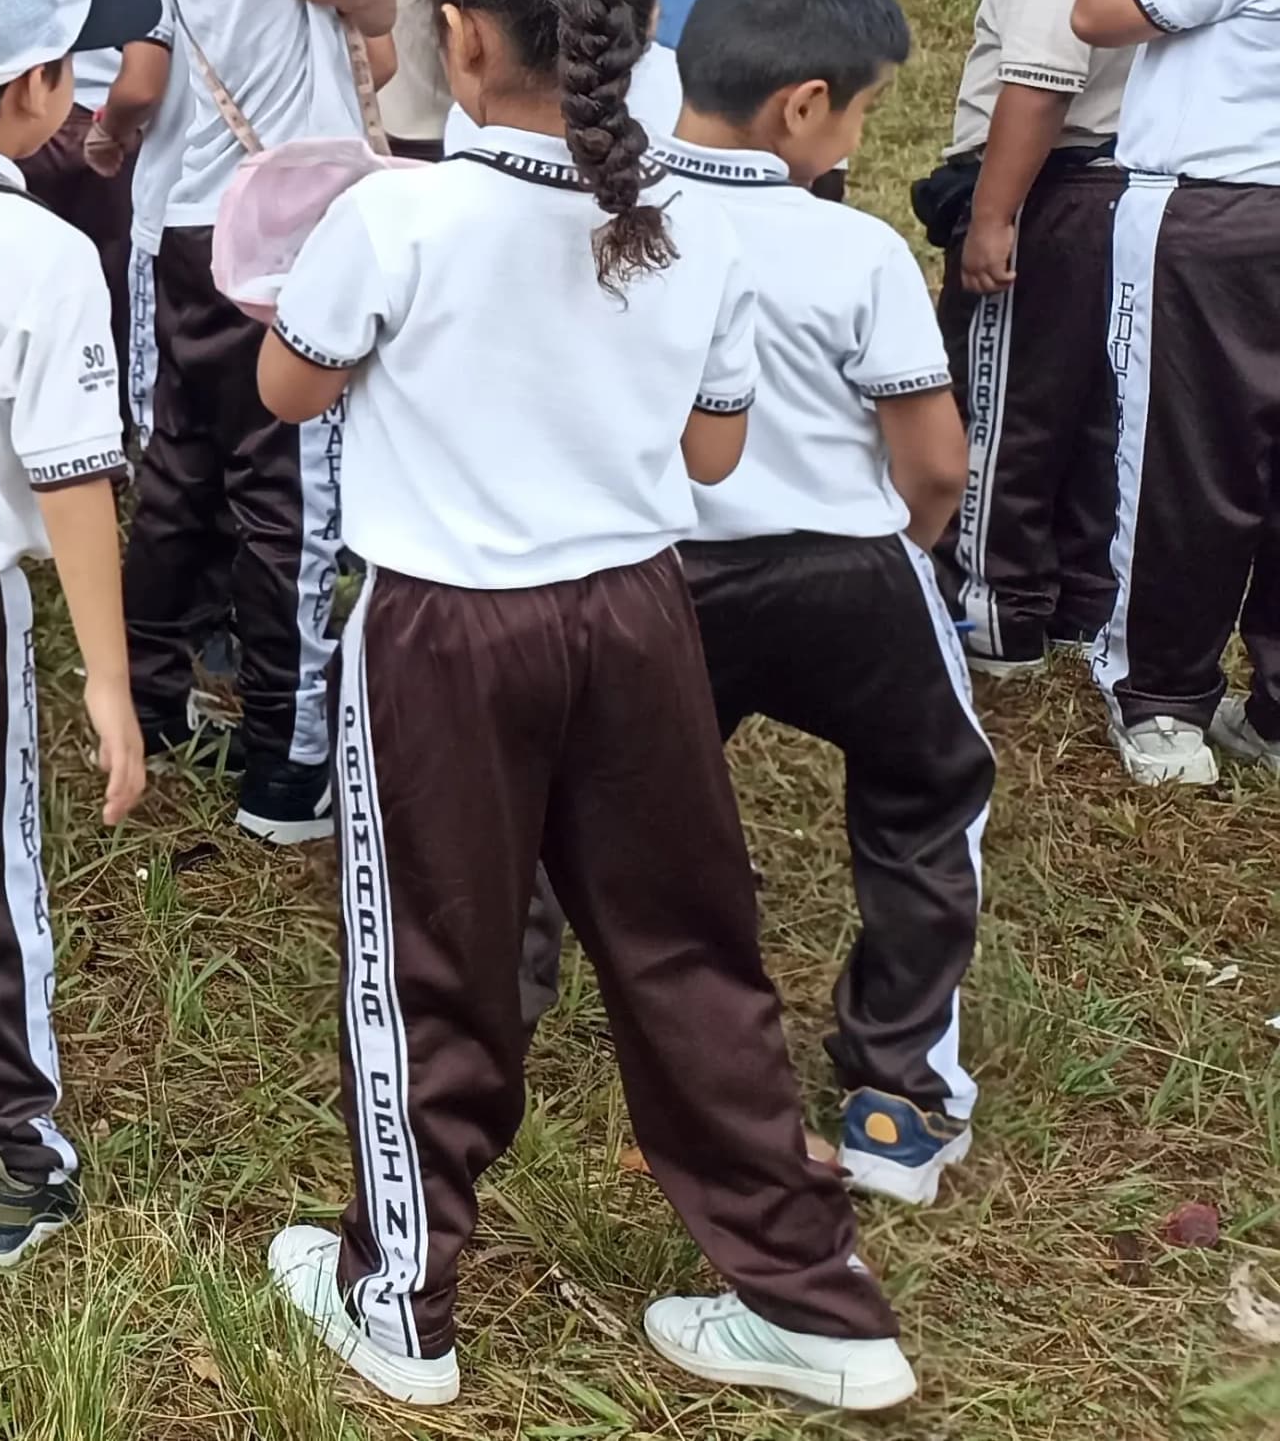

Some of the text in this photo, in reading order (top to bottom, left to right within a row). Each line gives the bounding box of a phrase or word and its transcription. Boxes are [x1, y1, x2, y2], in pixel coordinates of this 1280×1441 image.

[654, 150, 758, 179] PRIMARIA
[973, 302, 1000, 448] RIMARIA
[30, 449, 126, 482] DUCACIO
[344, 705, 385, 1028] PRIMARIA
[370, 1070, 405, 1183] CEI
